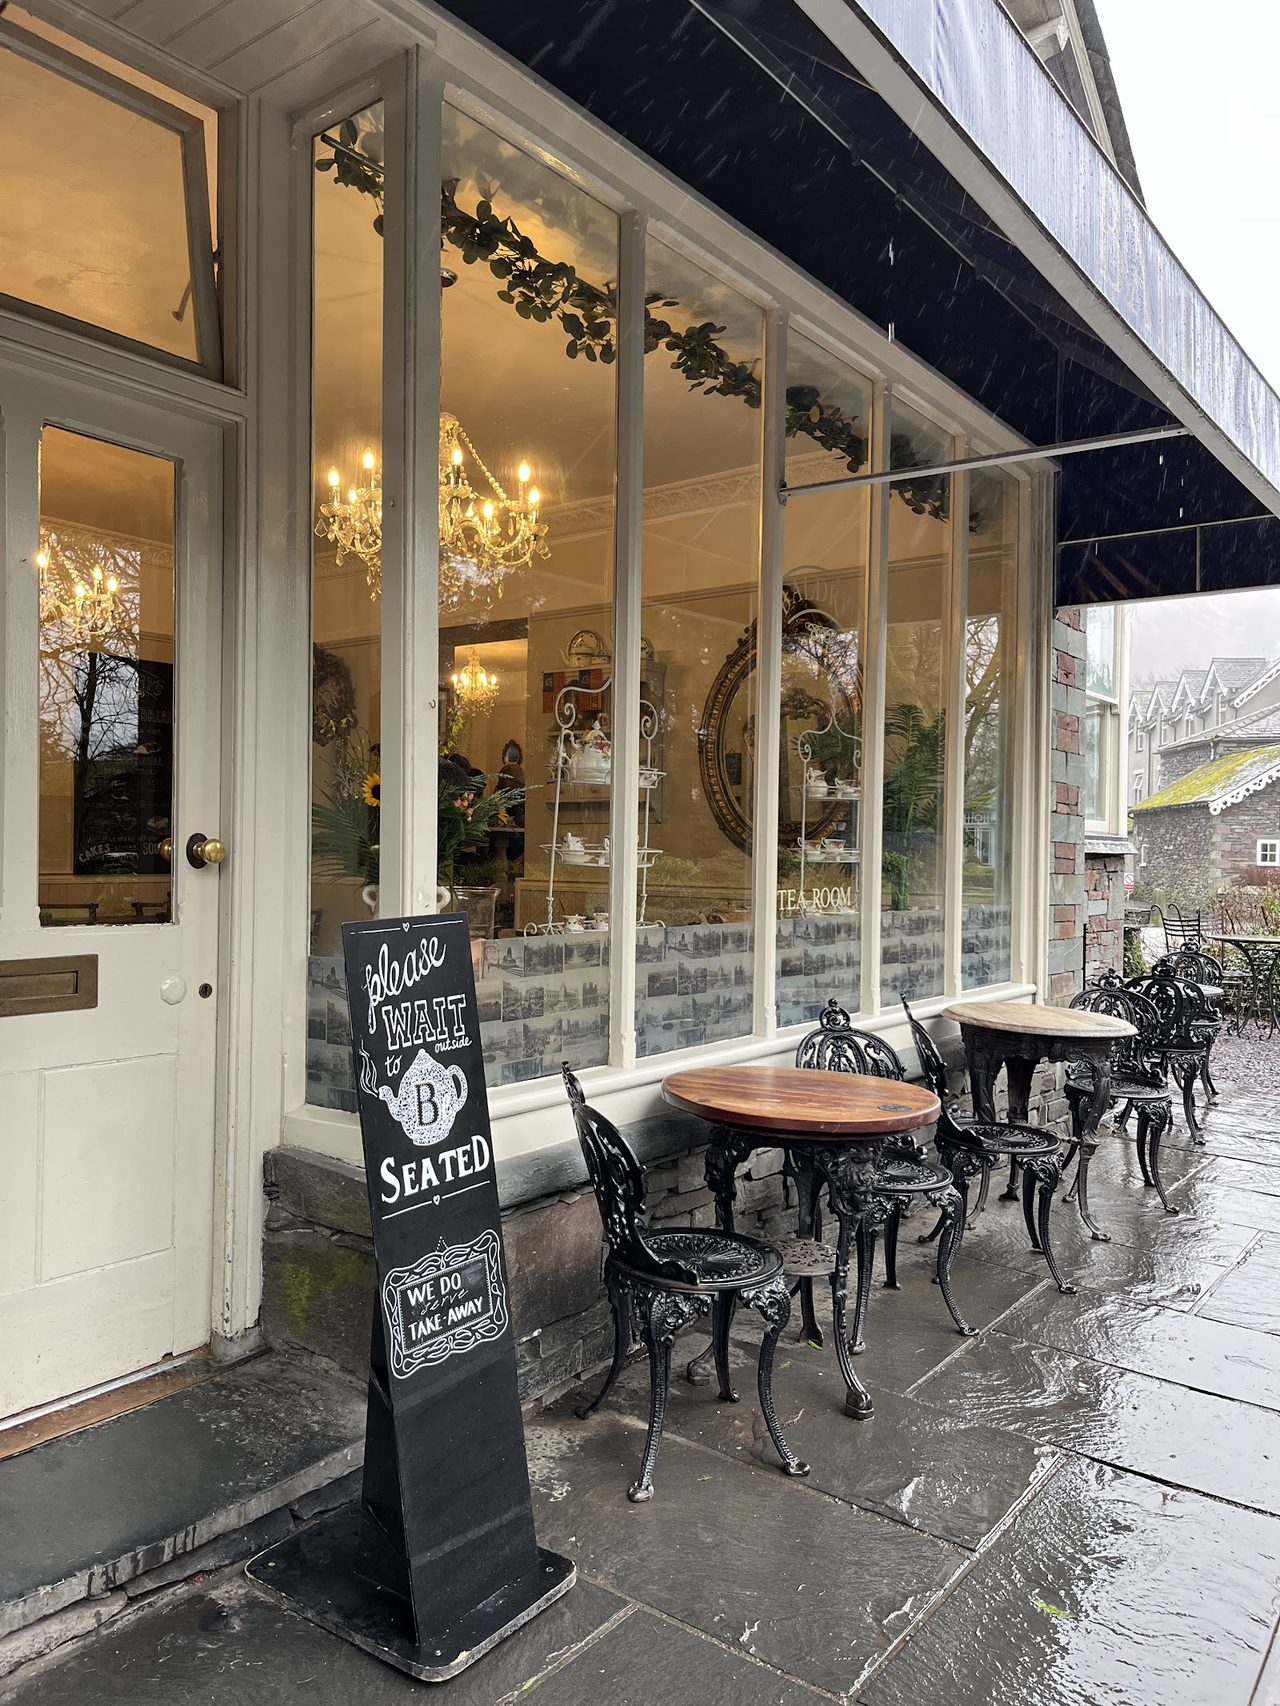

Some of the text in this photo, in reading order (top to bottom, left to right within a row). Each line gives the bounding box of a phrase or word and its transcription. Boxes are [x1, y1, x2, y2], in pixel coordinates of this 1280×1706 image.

[79, 844, 110, 862] CAKES
[143, 842, 160, 855] SOU
[777, 886, 852, 910] TEA ROOM
[362, 936, 447, 1034] please
[382, 994, 467, 1050] WAIT
[435, 1036, 472, 1053] outside
[385, 1054, 402, 1077] to
[414, 1081, 440, 1127] B
[380, 1134, 490, 1204] SEATED
[407, 1272, 461, 1307] WE DO
[420, 1288, 469, 1315] serve
[408, 1296, 483, 1341] TAKE-AWAY
